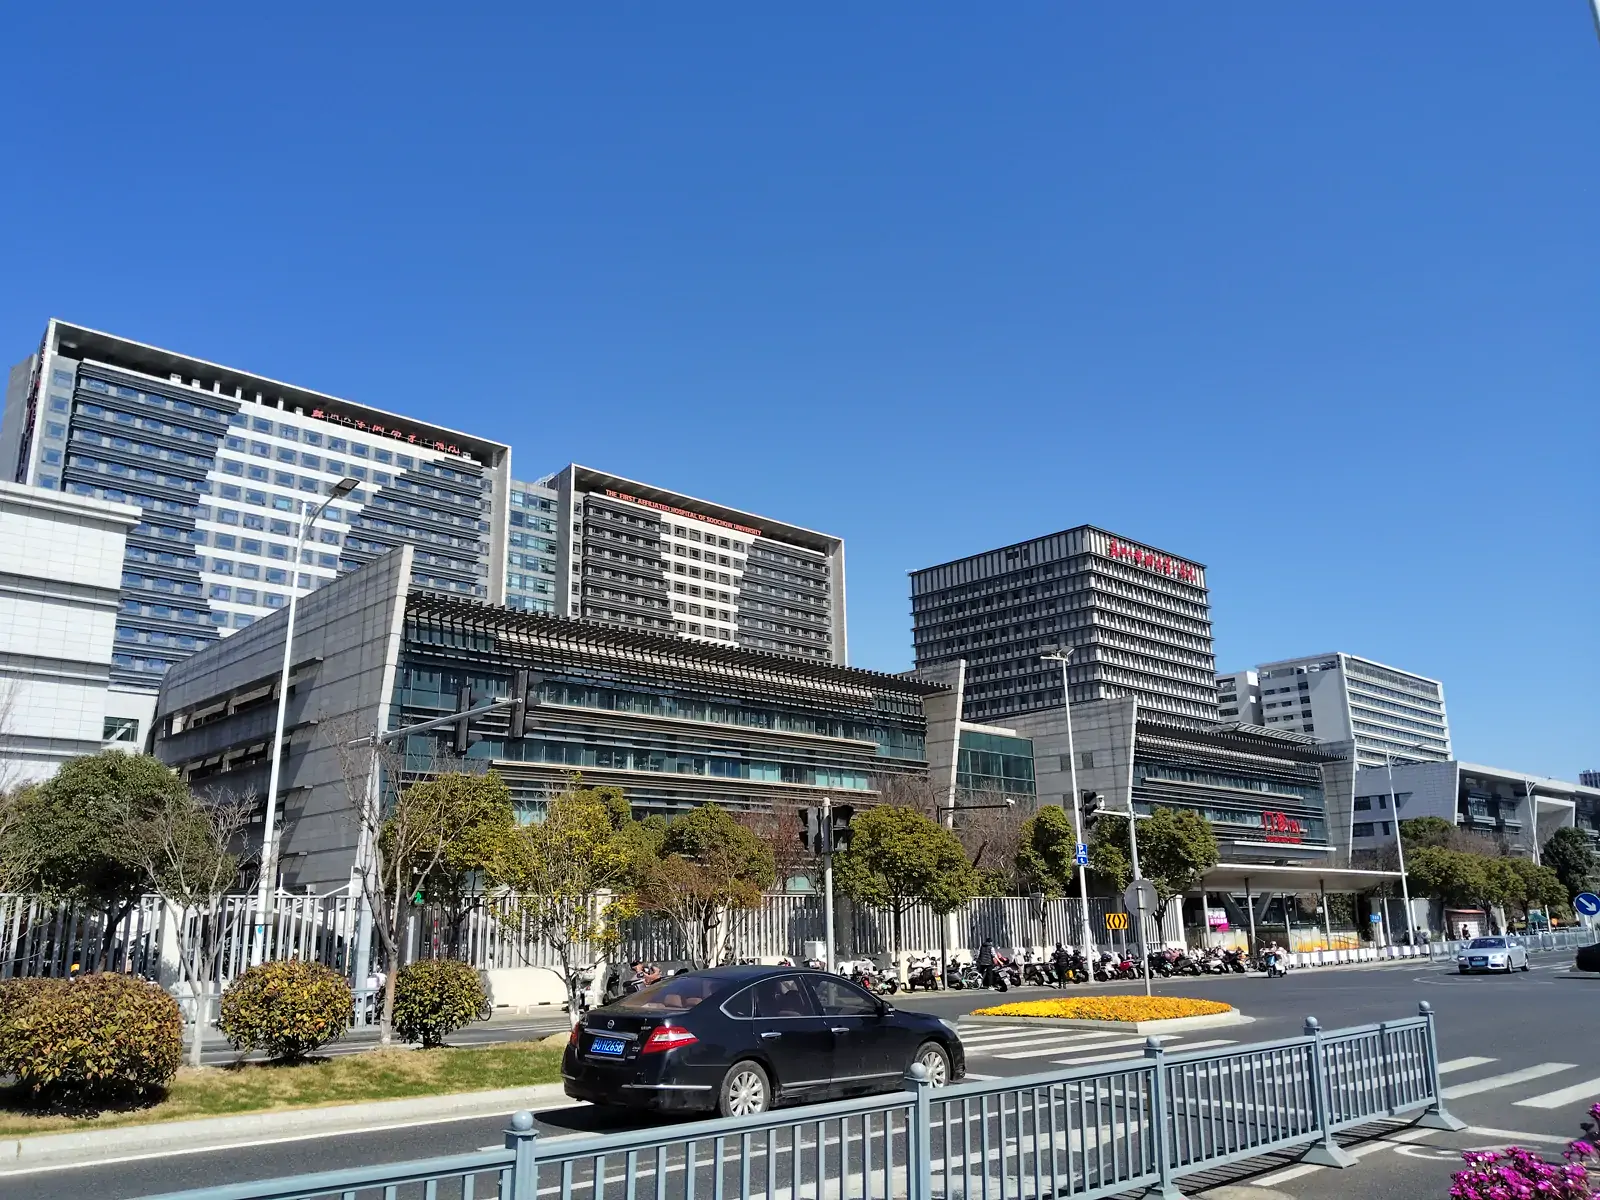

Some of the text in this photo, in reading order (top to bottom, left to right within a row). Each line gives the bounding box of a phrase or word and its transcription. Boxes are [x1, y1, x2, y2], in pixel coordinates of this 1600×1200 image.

[605, 489, 617, 497] THE
[619, 493, 636, 502] FIRST
[637, 498, 670, 511] AFFILIATED
[670, 506, 698, 520] HOSPITAL
[706, 516, 734, 528] SOOCHOW
[733, 523, 762, 536] UNIVERSITY
